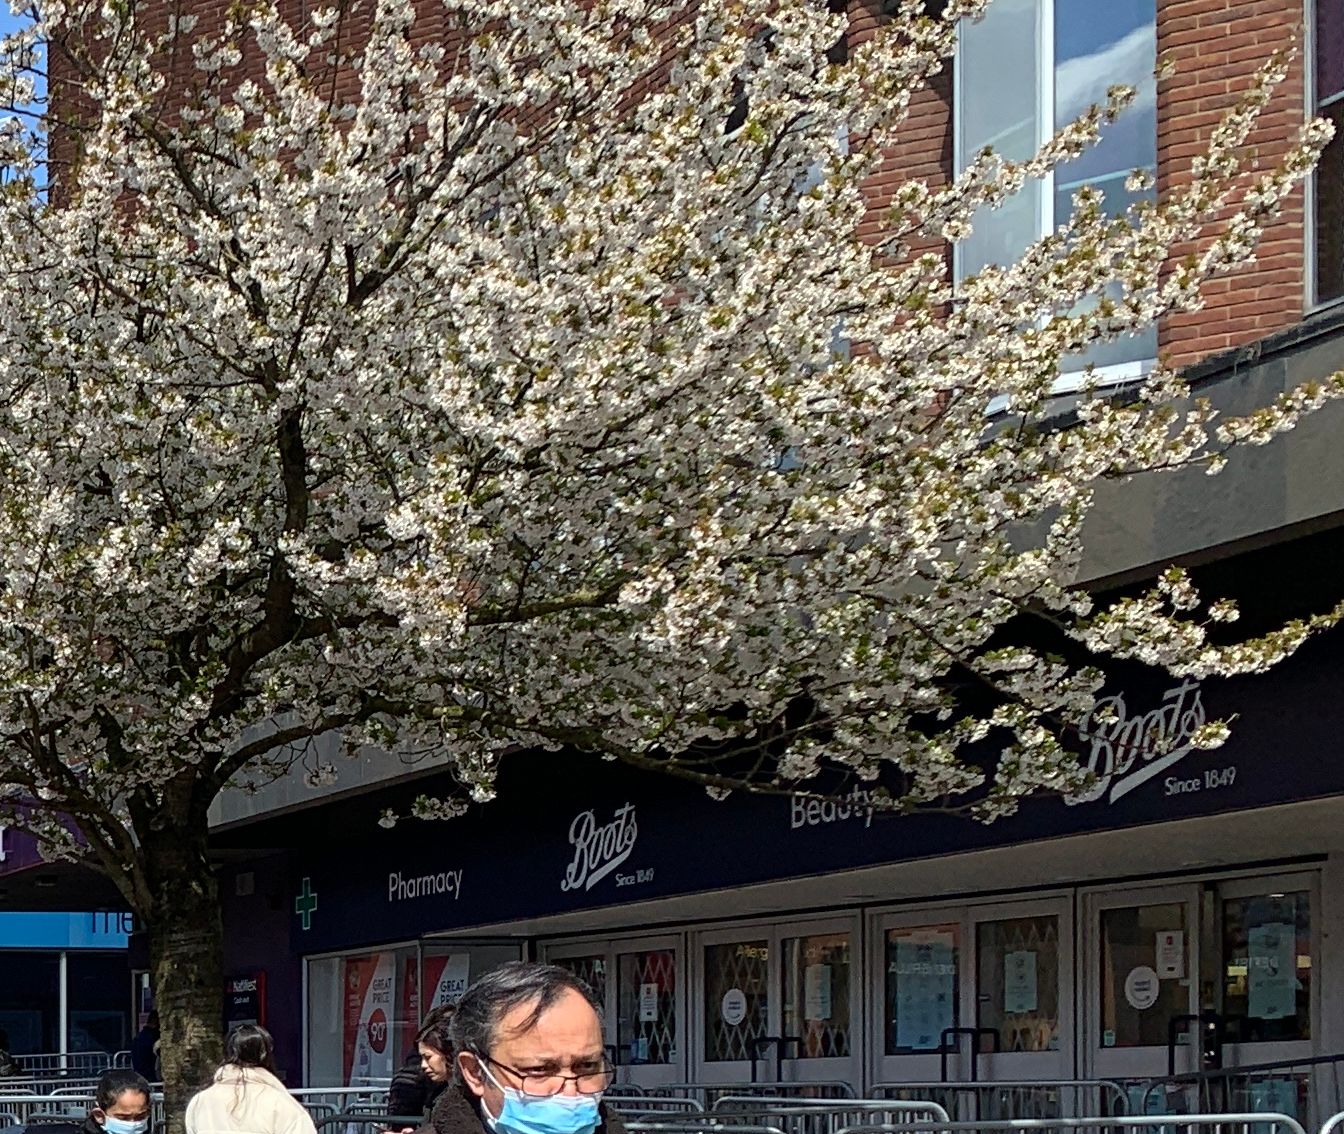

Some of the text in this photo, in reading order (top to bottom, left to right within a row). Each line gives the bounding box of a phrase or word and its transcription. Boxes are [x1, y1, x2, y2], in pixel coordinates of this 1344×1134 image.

[1164, 766, 1237, 796] Since 1849
[791, 783, 874, 829] Beauty
[561, 802, 638, 892] Boots
[389, 868, 463, 901] Pharmacy
[373, 978, 391, 990] GREAT
[373, 992, 389, 1003] PRICE
[440, 980, 464, 992] GREAT
